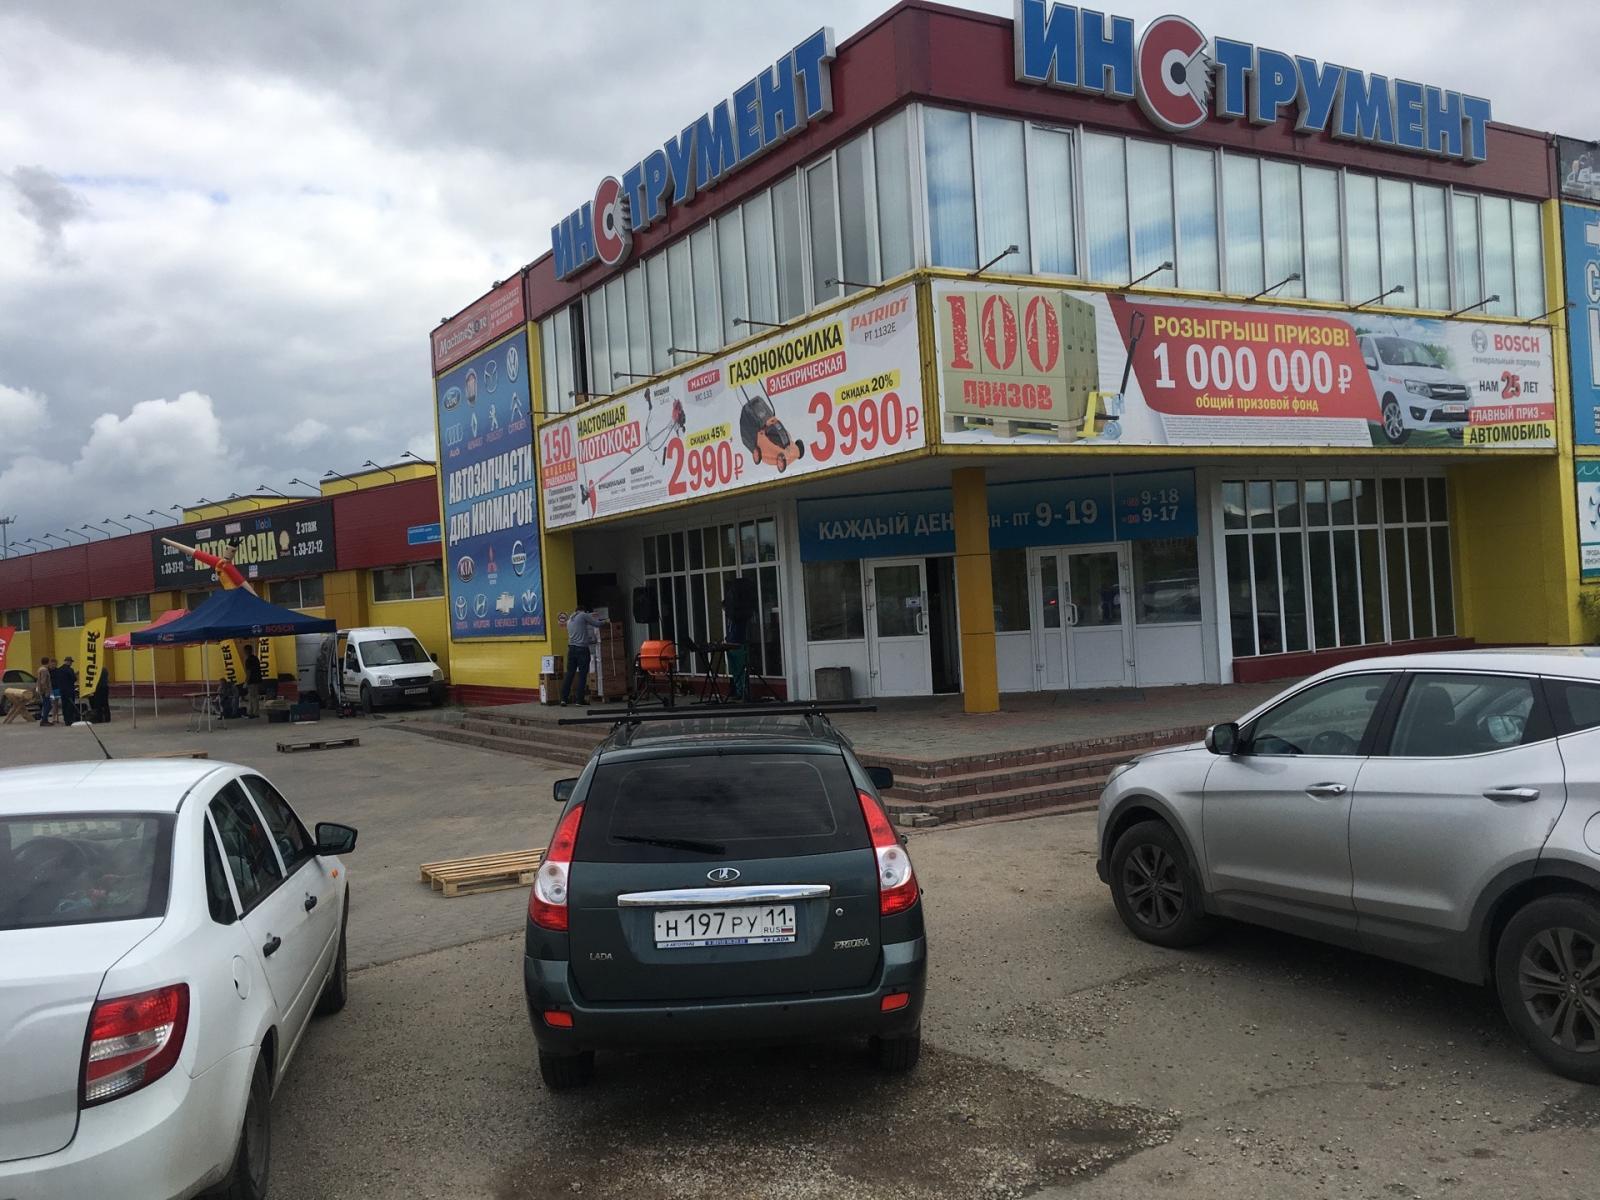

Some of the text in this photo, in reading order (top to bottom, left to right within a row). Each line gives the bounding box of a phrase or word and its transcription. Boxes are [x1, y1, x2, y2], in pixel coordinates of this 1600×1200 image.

[1015, 0, 1491, 164] ИНСТРУМЕНТ
[551, 26, 836, 280] ИНСТРУМЕНТ
[851, 295, 909, 331] PATRIOT
[946, 294, 1060, 373] 100
[1154, 316, 1350, 347] РОЗЫГРЫШ ПРИЗОВ!
[1494, 334, 1540, 353] BOSCH
[729, 324, 843, 385] ГАЗОНОКОСИЛКА
[769, 355, 843, 393] ЭЛЕКТРИЧЕСКАЯ
[841, 373, 894, 401] СКИДКА 20%
[1479, 371, 1539, 399] НАМ 25 ЛЕТ
[1195, 393, 1319, 413] общий призовой фонд
[1471, 406, 1514, 422] ГЛАВНЫЙ
[1516, 407, 1538, 419] ПРИЗ
[577, 405, 625, 436] НАСТОЯЩАЯ
[711, 425, 726, 439] 45%
[1469, 423, 1551, 444] АВТОМОБИЛЬ
[543, 425, 572, 464] 150
[578, 427, 638, 463] МОТОКОСА
[449, 443, 533, 504] АВТОЗАПЧАСТИ
[449, 511, 471, 547] ДЛЯ
[472, 488, 533, 537] ИНОМАРОК
[819, 511, 909, 540] КАЖДЫЙ
[914, 512, 955, 537] ДЕН
[763, 926, 780, 934] RUS
[589, 951, 613, 961] LADA
